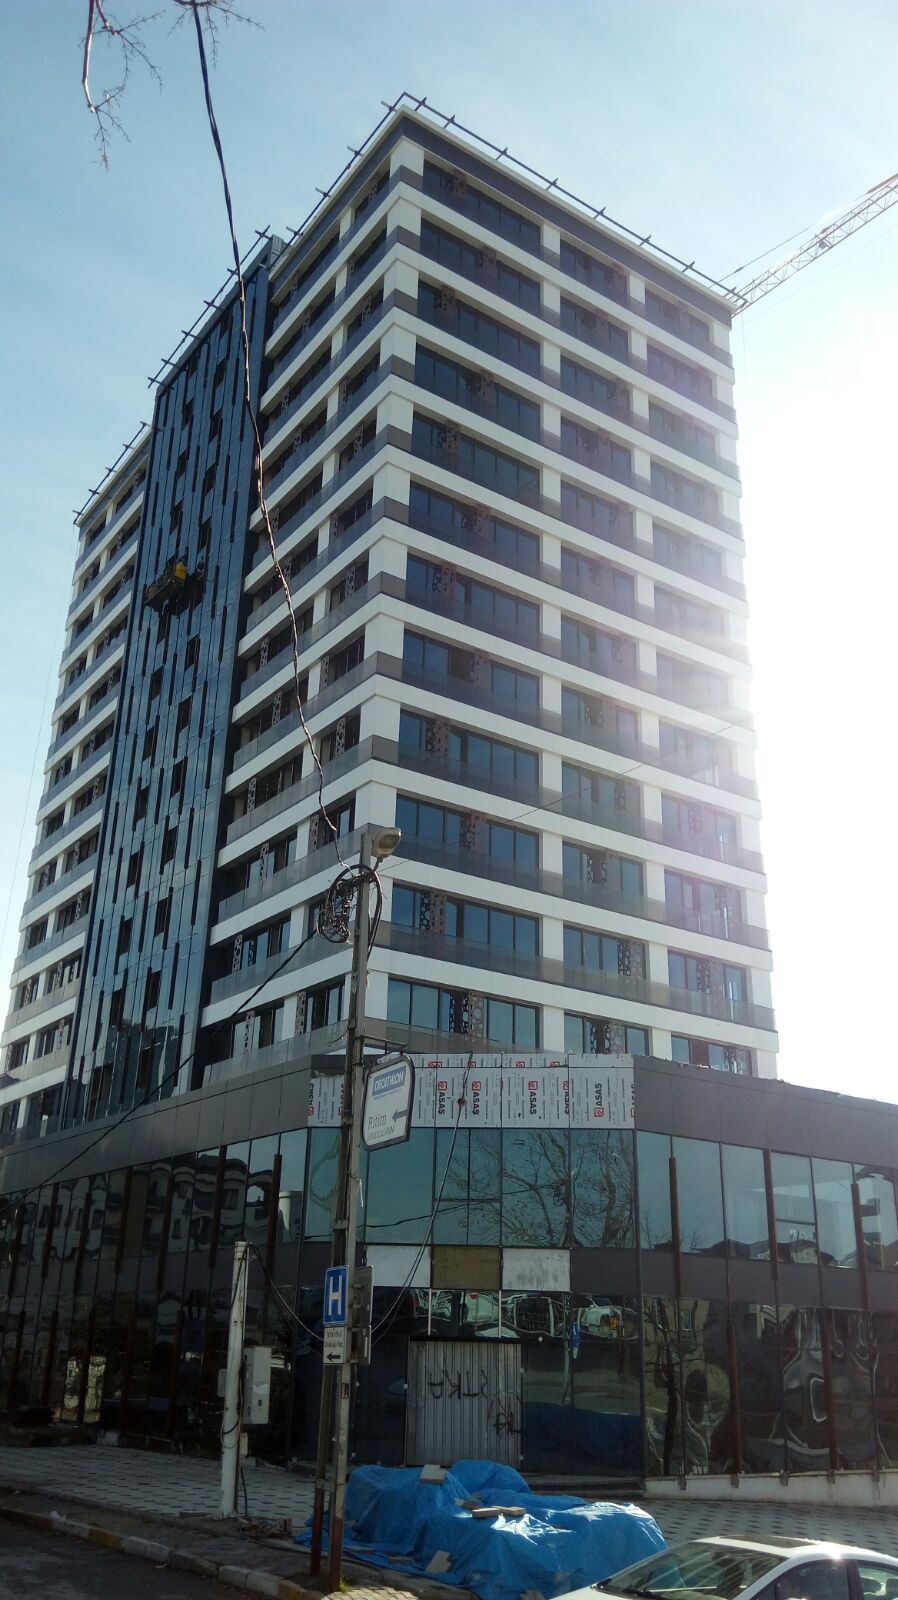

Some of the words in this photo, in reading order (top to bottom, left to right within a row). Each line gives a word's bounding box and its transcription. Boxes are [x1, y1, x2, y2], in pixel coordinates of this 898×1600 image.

[438, 1092, 446, 1115] ASAS
[472, 1092, 480, 1115] ASAS
[529, 1091, 537, 1115] ASAS
[328, 1274, 343, 1316] H
